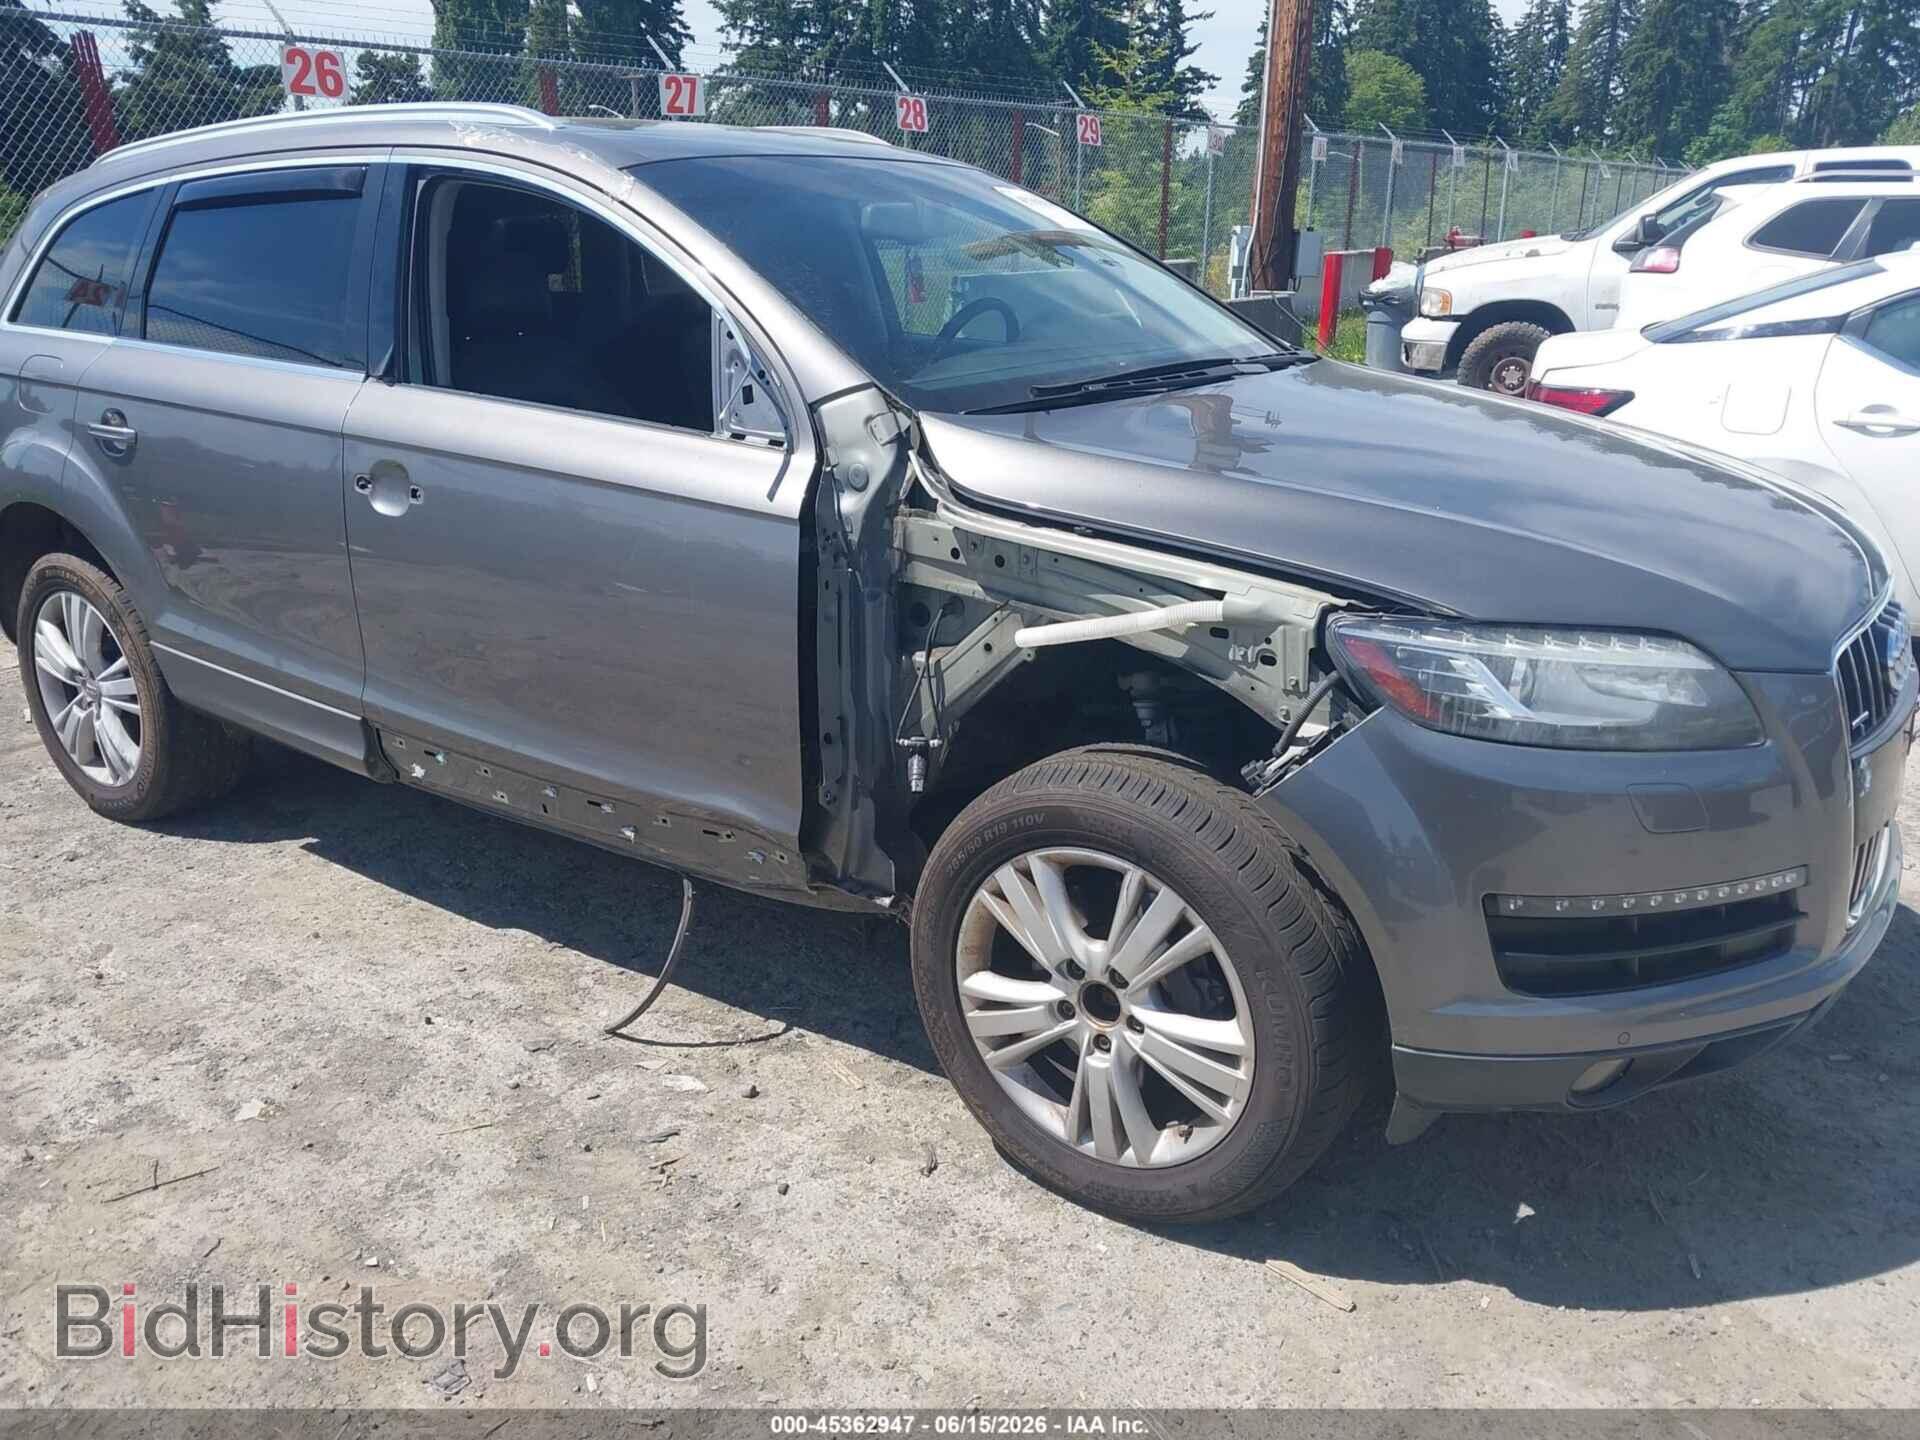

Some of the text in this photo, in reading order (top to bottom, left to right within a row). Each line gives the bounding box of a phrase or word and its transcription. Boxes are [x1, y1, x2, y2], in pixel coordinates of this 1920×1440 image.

[286, 48, 344, 97] 26
[665, 76, 697, 114] 27
[899, 97, 926, 130] 28
[1079, 115, 1099, 144] 29
[983, 821, 1009, 842] R19
[1011, 811, 1047, 830] 110V
